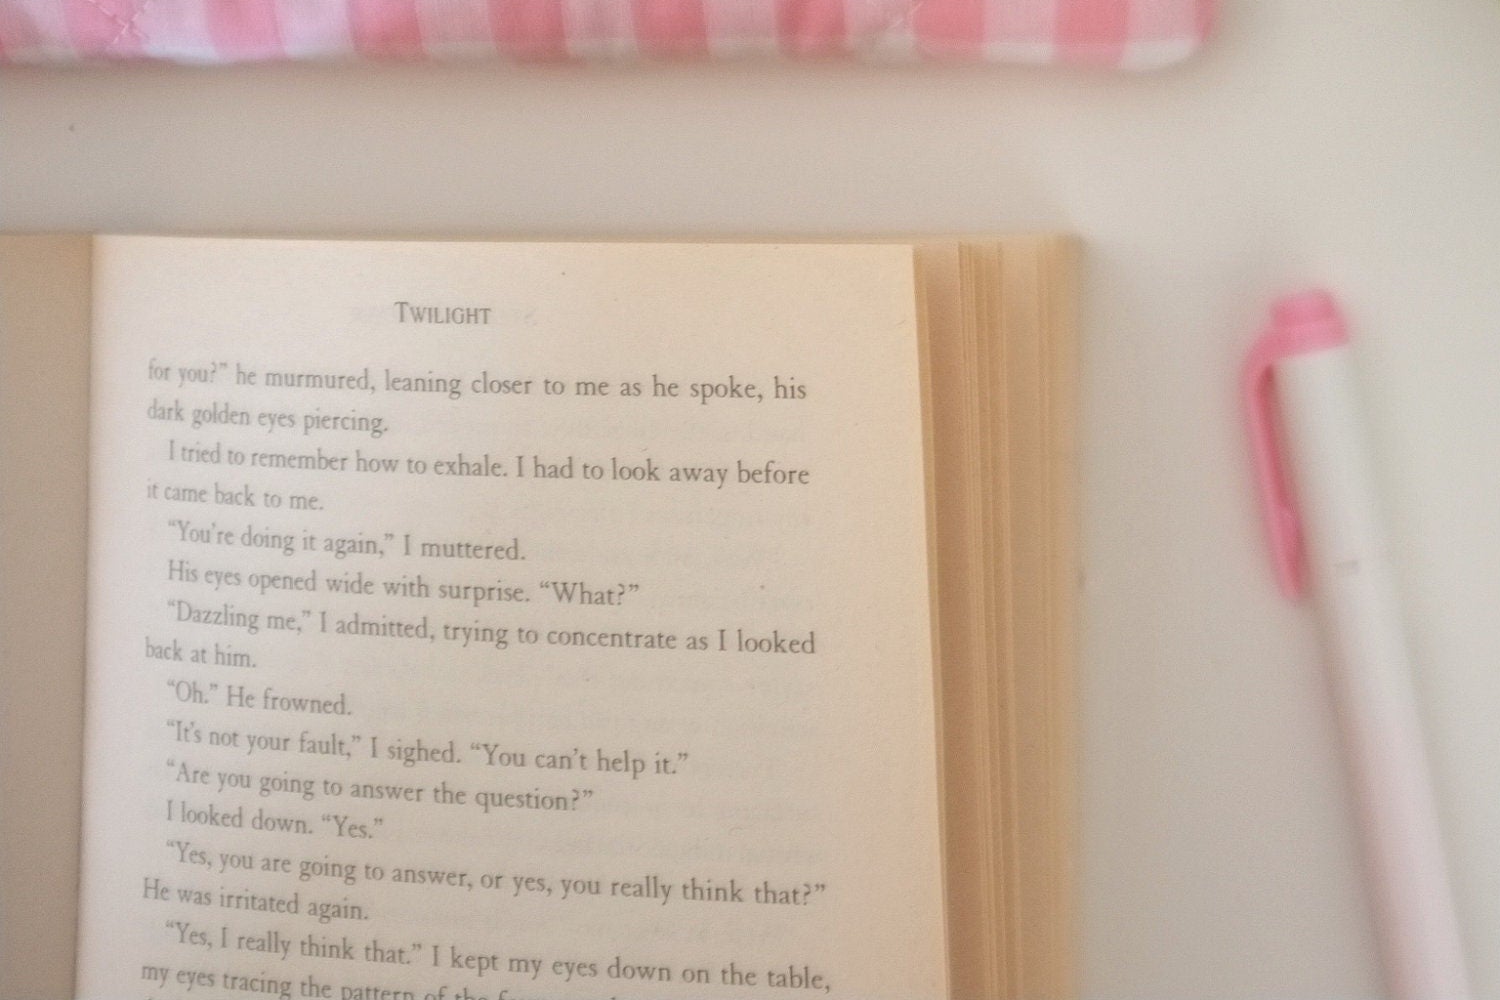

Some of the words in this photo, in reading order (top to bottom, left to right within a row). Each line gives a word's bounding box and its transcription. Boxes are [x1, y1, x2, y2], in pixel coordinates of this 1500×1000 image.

[148, 358, 172, 381] for
[236, 362, 257, 385] he
[265, 368, 376, 394] murmured,
[384, 369, 463, 400] leaning
[471, 371, 534, 394] closer
[543, 379, 567, 395] to
[575, 381, 610, 396] me
[620, 382, 644, 397] as
[651, 373, 680, 397] he
[690, 375, 764, 405] spoke,
[773, 375, 808, 399] his
[147, 398, 185, 421] dark
[191, 401, 252, 429] golden
[257, 412, 297, 433] eyes
[303, 407, 389, 439] piercing.
[169, 439, 176, 460] I
[181, 441, 222, 464] tried
[227, 449, 246, 465] to
[251, 447, 349, 472] remember
[355, 449, 400, 473] how
[406, 457, 428, 474] to
[433, 453, 508, 477] exhale.
[515, 455, 525, 478] I
[532, 455, 575, 479] had
[582, 463, 605, 480] to
[610, 457, 661, 481] look
[669, 467, 729, 490] away
[737, 459, 810, 485] before
[147, 478, 159, 500] it
[164, 486, 208, 503] came
[214, 482, 256, 507] back
[263, 492, 282, 508] to
[289, 495, 324, 510] me.
[240, 524, 296, 556] doing
[302, 529, 317, 551] it
[404, 534, 411, 556] I
[421, 537, 526, 560] muttered.
[168, 559, 198, 582] His
[204, 570, 242, 591] eyes
[248, 569, 318, 595] opened
[325, 571, 375, 595] wide
[382, 575, 431, 598] with
[438, 579, 530, 607] surprise.
[145, 636, 183, 661] back
[190, 648, 207, 664] at
[214, 643, 256, 668] him.
[319, 610, 327, 633] I
[335, 612, 436, 643] admitted,
[442, 620, 510, 650] trying
[516, 627, 542, 644] to
[546, 630, 678, 649] concentrate
[686, 635, 709, 651] as
[717, 629, 727, 651] I
[737, 627, 817, 654] looked
[227, 685, 256, 708] He
[263, 687, 352, 715] frowned.
[209, 731, 240, 747] not
[246, 734, 291, 755] your
[370, 736, 378, 758] I
[387, 738, 462, 768] sighed.
[596, 748, 647, 780] help
[217, 772, 252, 793] you
[259, 771, 316, 801] going
[322, 779, 344, 796] to
[350, 783, 426, 802] answer
[432, 781, 467, 805] the
[167, 799, 173, 821] I
[181, 801, 244, 828] looked
[251, 808, 314, 834] down.
[142, 877, 171, 901] He
[177, 889, 212, 906] was
[220, 886, 301, 914] irritated
[307, 897, 370, 924] again.
[219, 853, 255, 873] you
[261, 857, 291, 873] are
[299, 855, 357, 885] going
[364, 863, 385, 880] to
[391, 868, 474, 892] answer,
[480, 872, 506, 889] or
[512, 874, 553, 897] yes,
[560, 878, 602, 900] you
[611, 875, 674, 906] really
[682, 877, 744, 902] think
[221, 927, 229, 948] I
[237, 930, 292, 960] really
[300, 934, 355, 960] think
[432, 944, 440, 967] I
[450, 945, 500, 977] kept
[508, 957, 544, 980] my
[552, 960, 599, 982] eyes
[606, 956, 673, 982] down
[680, 967, 711, 984] on
[720, 962, 758, 986] the
[767, 964, 831, 994] table,
[141, 966, 170, 989] my
[176, 970, 216, 992] eyes
[222, 971, 292, 1000] tracing
[300, 974, 332, 998] the
[341, 985, 416, 1000] pattern
